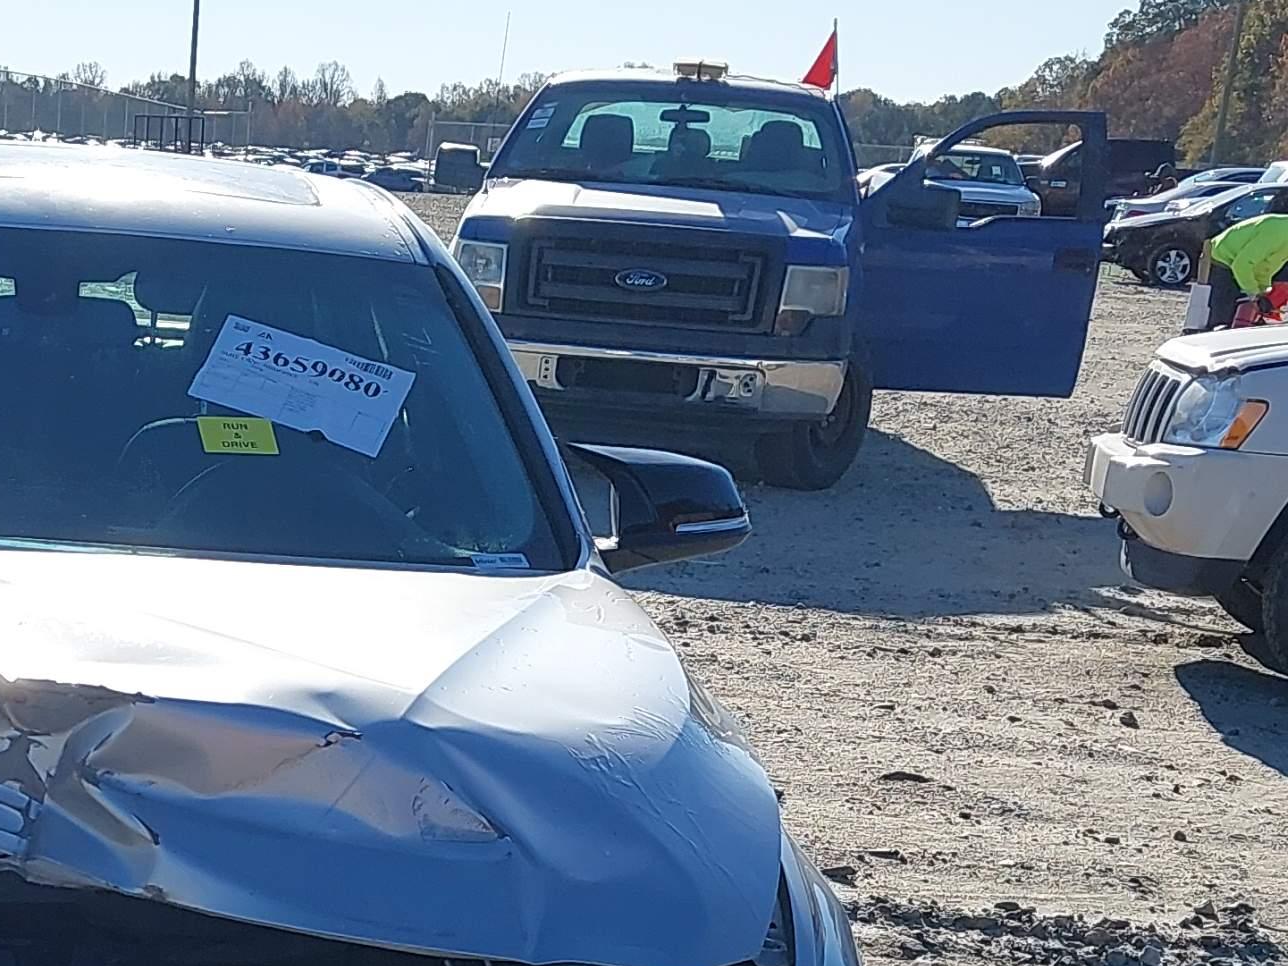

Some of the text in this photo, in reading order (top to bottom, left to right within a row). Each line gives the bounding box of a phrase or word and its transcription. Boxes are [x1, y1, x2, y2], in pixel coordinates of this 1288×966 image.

[626, 272, 656, 286] Ford
[235, 341, 381, 397] 43659080
[221, 422, 249, 431] RUN
[222, 440, 258, 449] DRIVE
